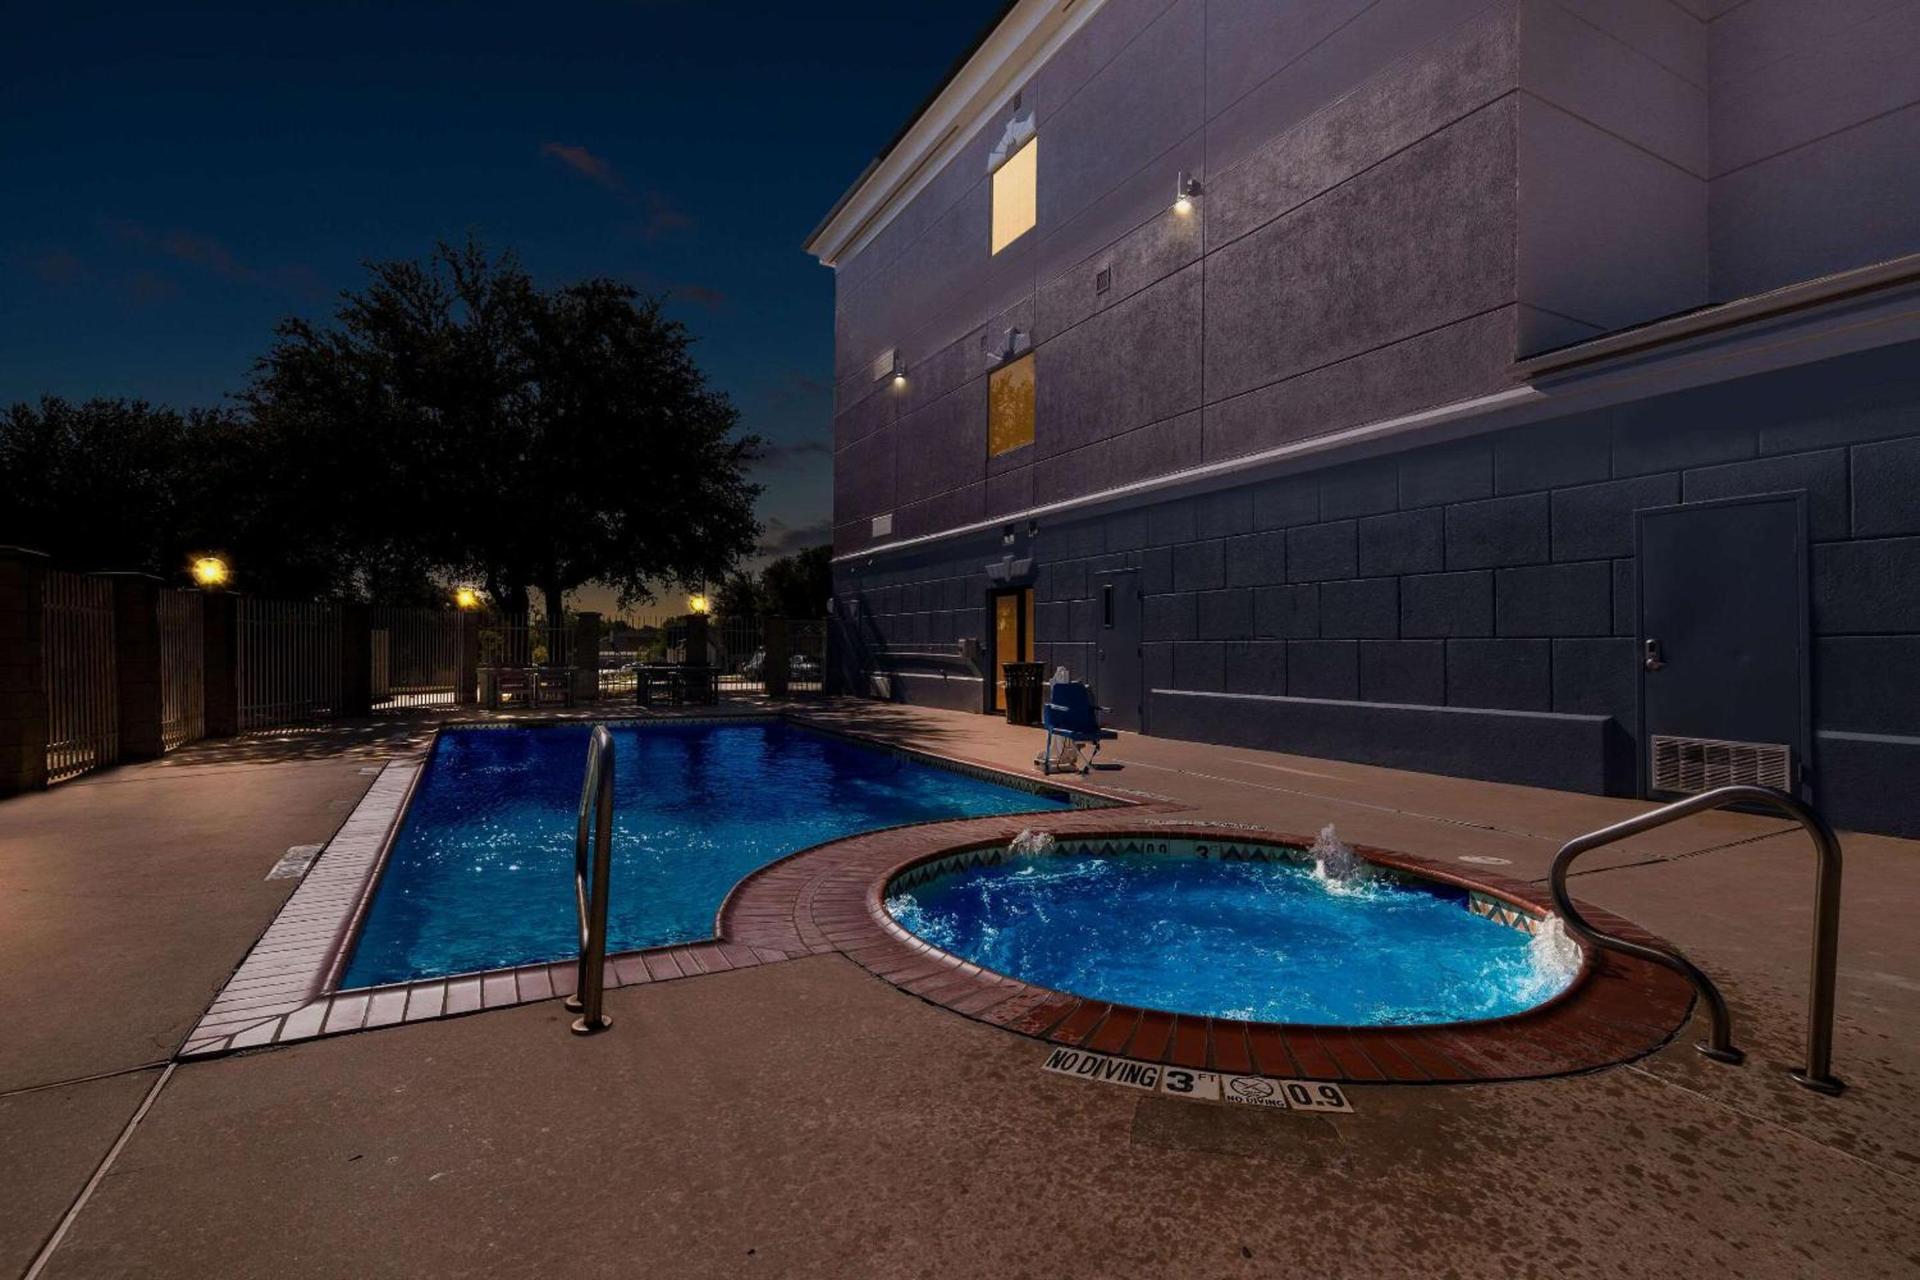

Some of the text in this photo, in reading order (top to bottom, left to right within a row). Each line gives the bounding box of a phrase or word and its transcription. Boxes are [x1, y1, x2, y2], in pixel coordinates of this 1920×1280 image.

[1046, 1050, 1158, 1088] NO DIVING
[1166, 1071, 1217, 1092] 3 FT
[1227, 1095, 1285, 1107] NO DIVING
[1287, 1083, 1345, 1107] 0.9
